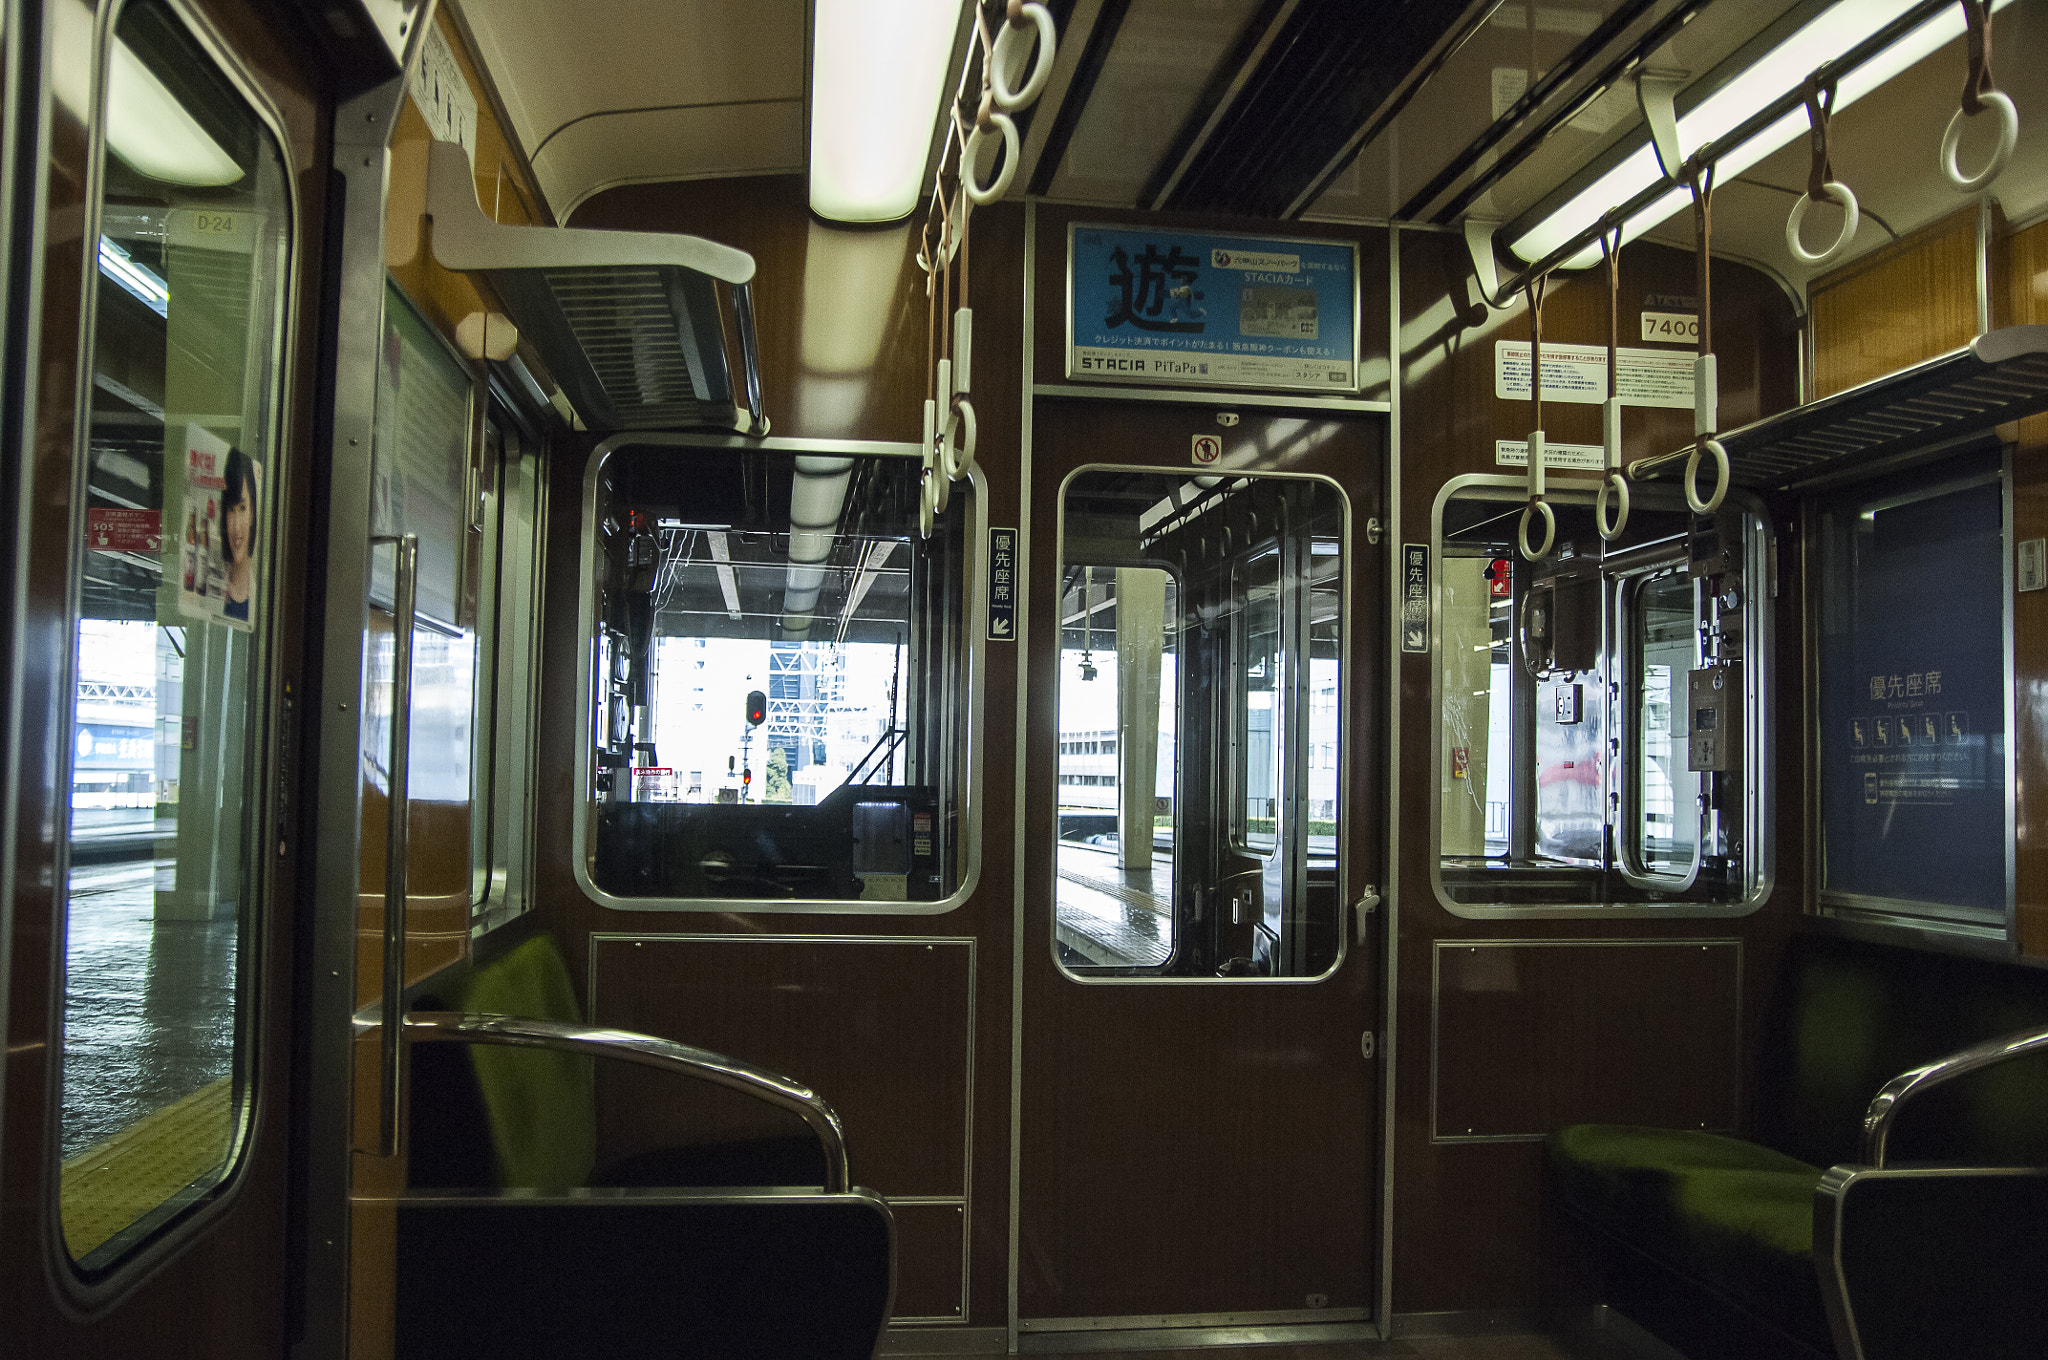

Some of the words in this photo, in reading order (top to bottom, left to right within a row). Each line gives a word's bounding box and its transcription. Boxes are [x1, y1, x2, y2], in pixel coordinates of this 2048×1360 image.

[198, 215, 232, 232] D-24
[1244, 272, 1314, 286] STACIAカード
[1105, 244, 1206, 334] 遊
[1645, 318, 1698, 337] 7400
[1082, 357, 1145, 371] STACIA
[1155, 360, 1196, 374] PiTaPa
[93, 522, 114, 531] SOS
[994, 535, 1011, 601] 優先座席
[1409, 551, 1425, 614] 優先座席
[1870, 670, 1942, 701] 優先座席
